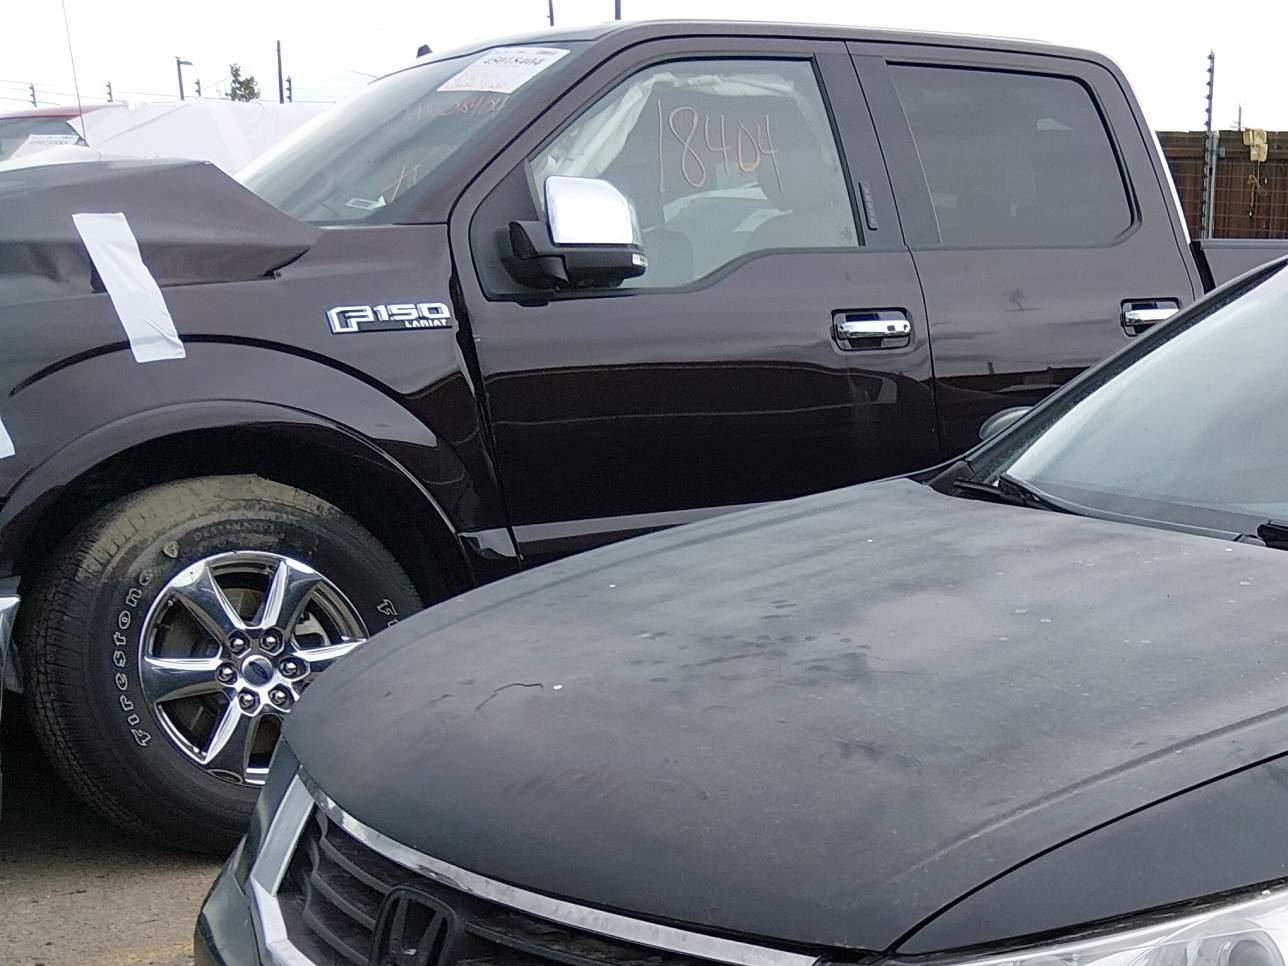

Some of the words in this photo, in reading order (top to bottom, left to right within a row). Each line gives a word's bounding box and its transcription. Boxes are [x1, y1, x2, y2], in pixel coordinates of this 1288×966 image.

[656, 98, 783, 194] 18404
[405, 319, 447, 328] LARIAT
[113, 568, 153, 747] Firestone
